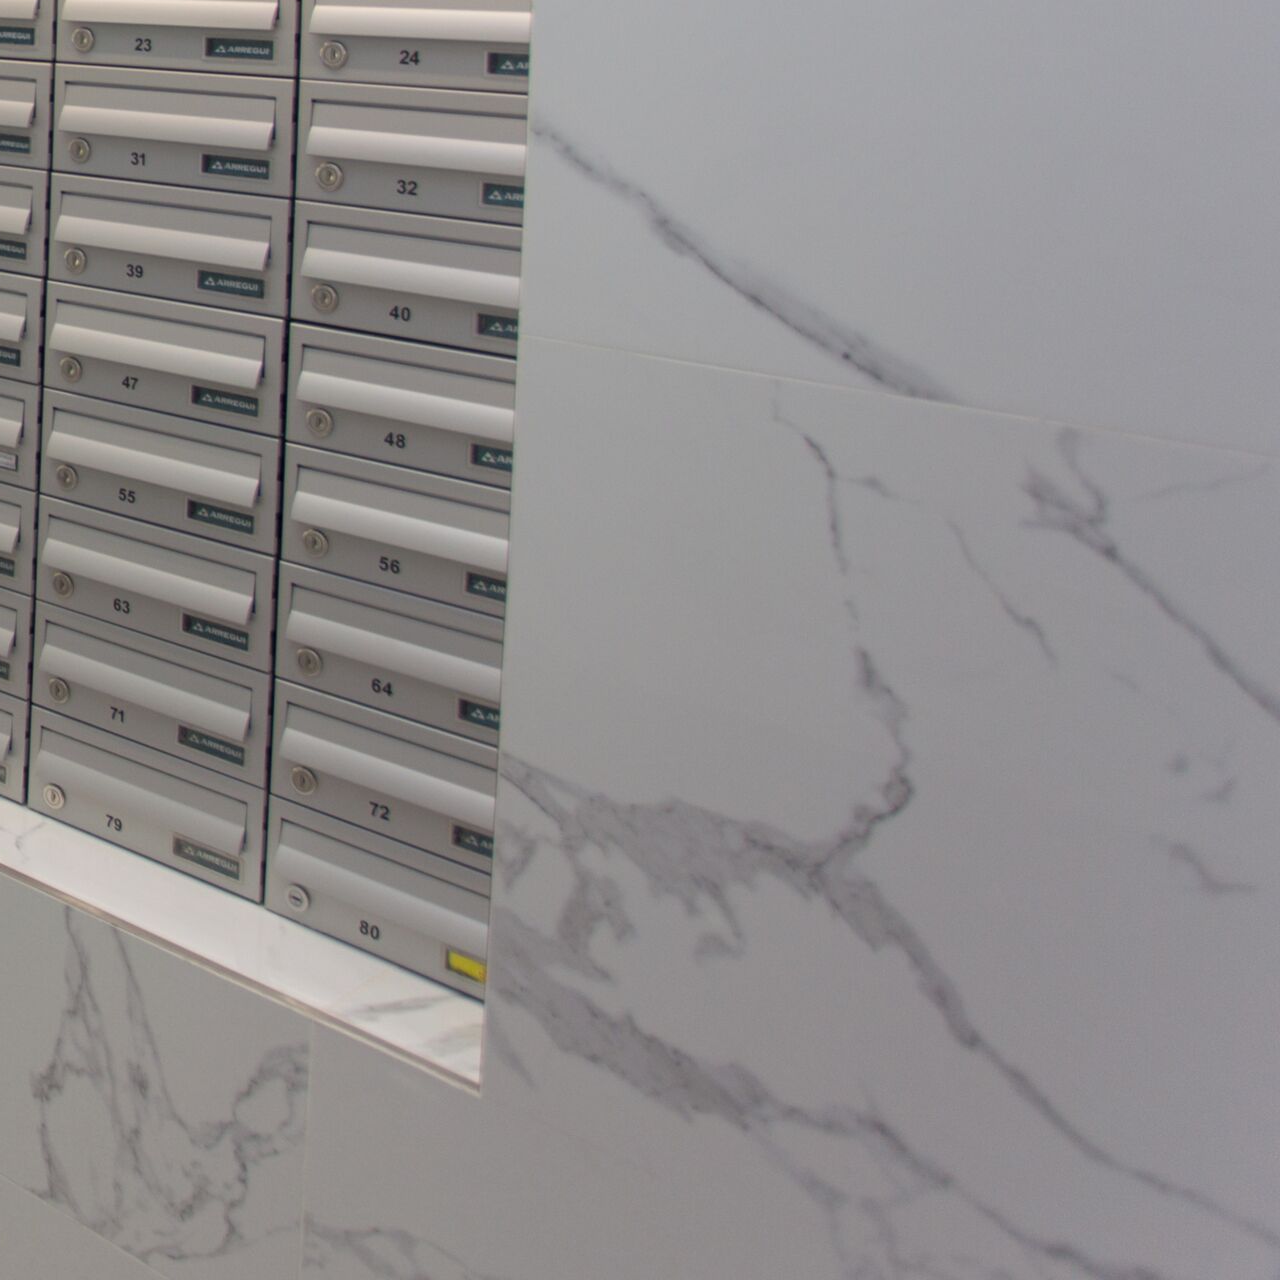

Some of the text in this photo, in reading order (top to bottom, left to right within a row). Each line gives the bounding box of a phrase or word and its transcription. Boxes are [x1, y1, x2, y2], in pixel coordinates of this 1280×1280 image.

[134, 37, 153, 53] 23
[398, 49, 421, 66] 24
[130, 151, 146, 167] 31
[224, 162, 266, 173] ARREGUI
[396, 178, 419, 197] 32
[126, 263, 145, 279] 39
[216, 279, 258, 291] ARREGUI
[388, 305, 412, 323] 40
[121, 375, 139, 391] 47
[214, 396, 256, 410] ARREGUI
[383, 431, 407, 450] 48
[118, 487, 136, 505] 55
[209, 511, 251, 527] ARREGUI
[378, 555, 401, 575] 56
[112, 597, 131, 615] 63
[205, 626, 246, 643] ARREGUI
[370, 677, 394, 697] 64
[109, 705, 125, 724] 71
[201, 738, 242, 757] ARREGUI
[369, 800, 391, 822] 72
[105, 813, 123, 833] 79
[196, 849, 237, 871] ARREGUI
[359, 919, 381, 941] 80
